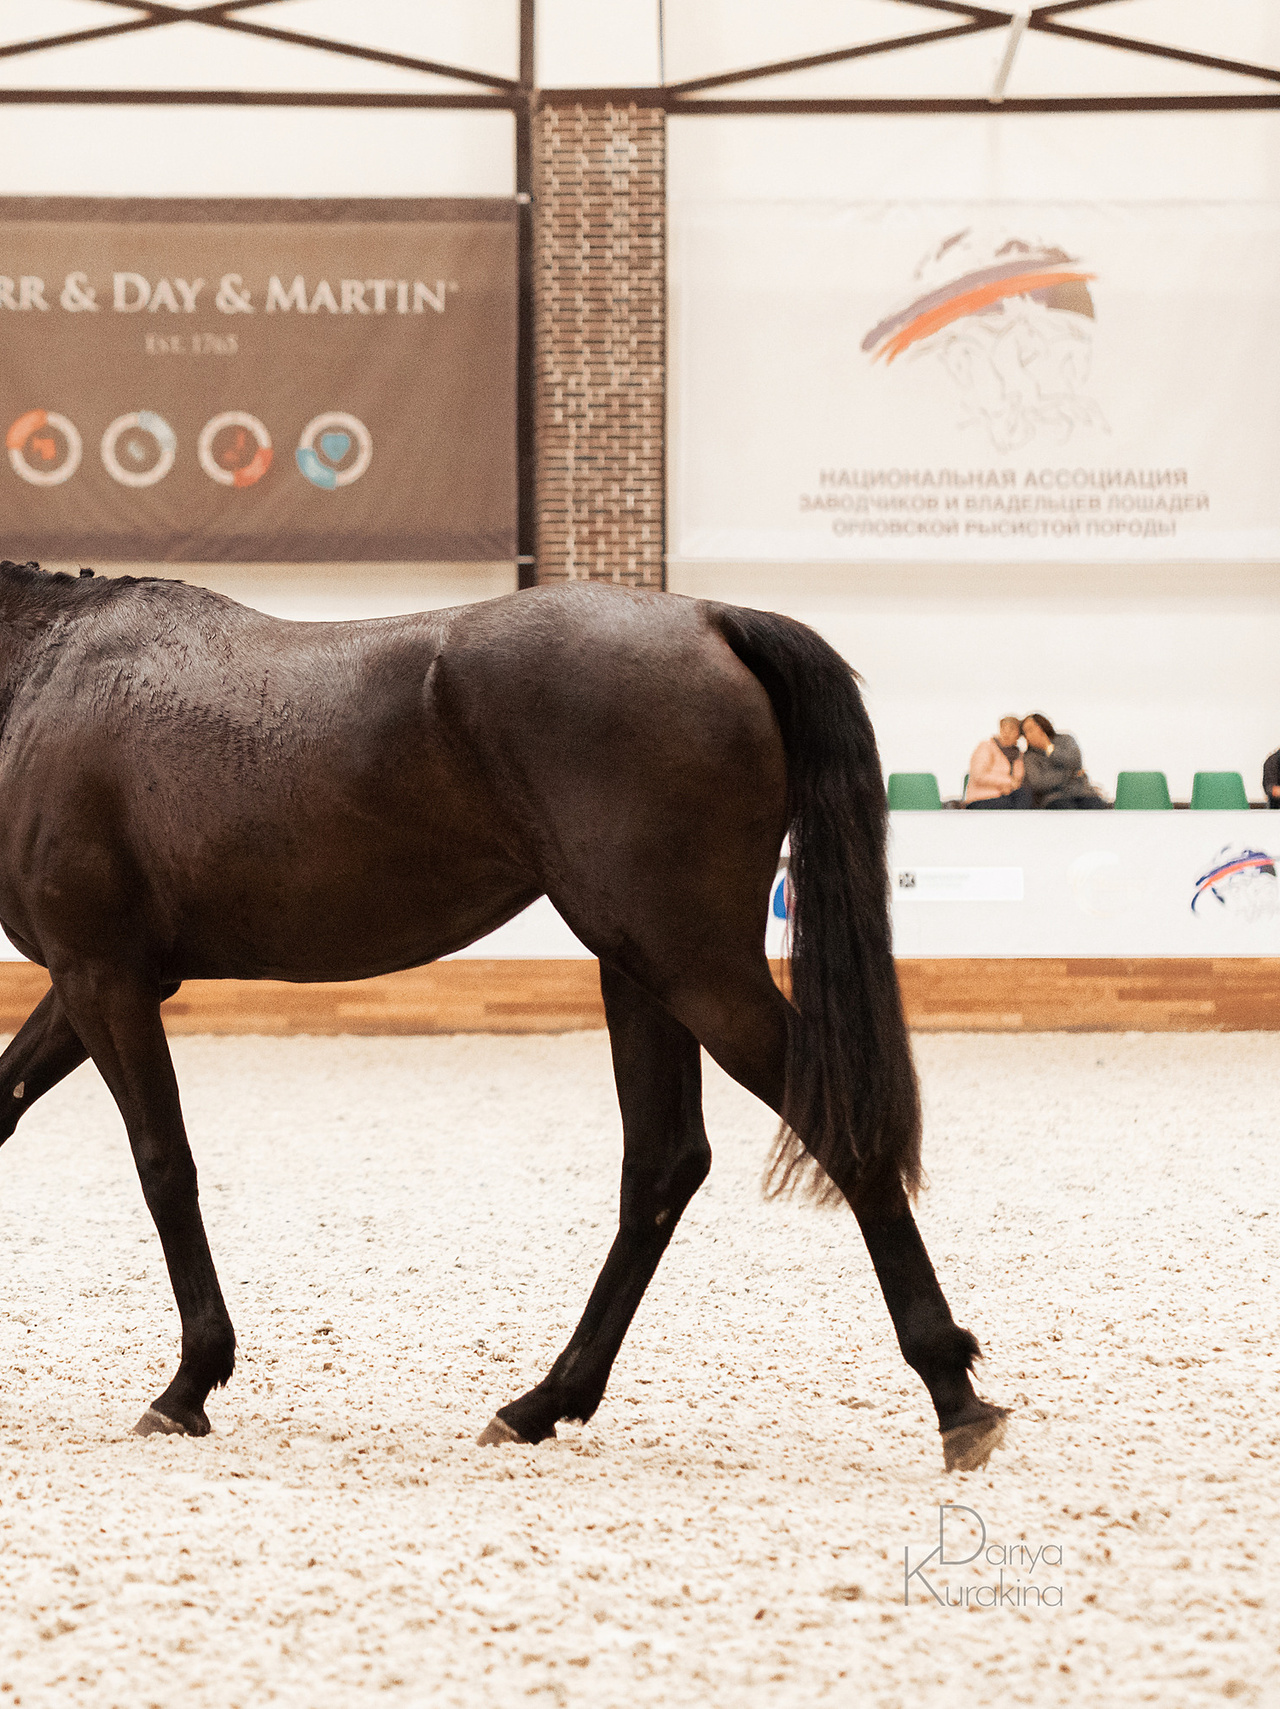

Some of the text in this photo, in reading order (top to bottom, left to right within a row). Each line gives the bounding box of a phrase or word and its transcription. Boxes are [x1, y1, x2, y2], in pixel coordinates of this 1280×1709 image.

[61, 271, 96, 312] &
[113, 272, 205, 313] DAY
[216, 273, 255, 313] &
[820, 468, 1189, 491] НАЦИОНАЛЬНАЯ АССОЦИАЦИЯ
[799, 491, 1211, 514] ЗАВОДЧИКОВ И ВЛАДЕЛЬЦЕВ ЛОШАДЕЙ
[831, 518, 1177, 539] ОРЛОВСКОЙ РЫСИСТОЙ ПОРОДЫ
